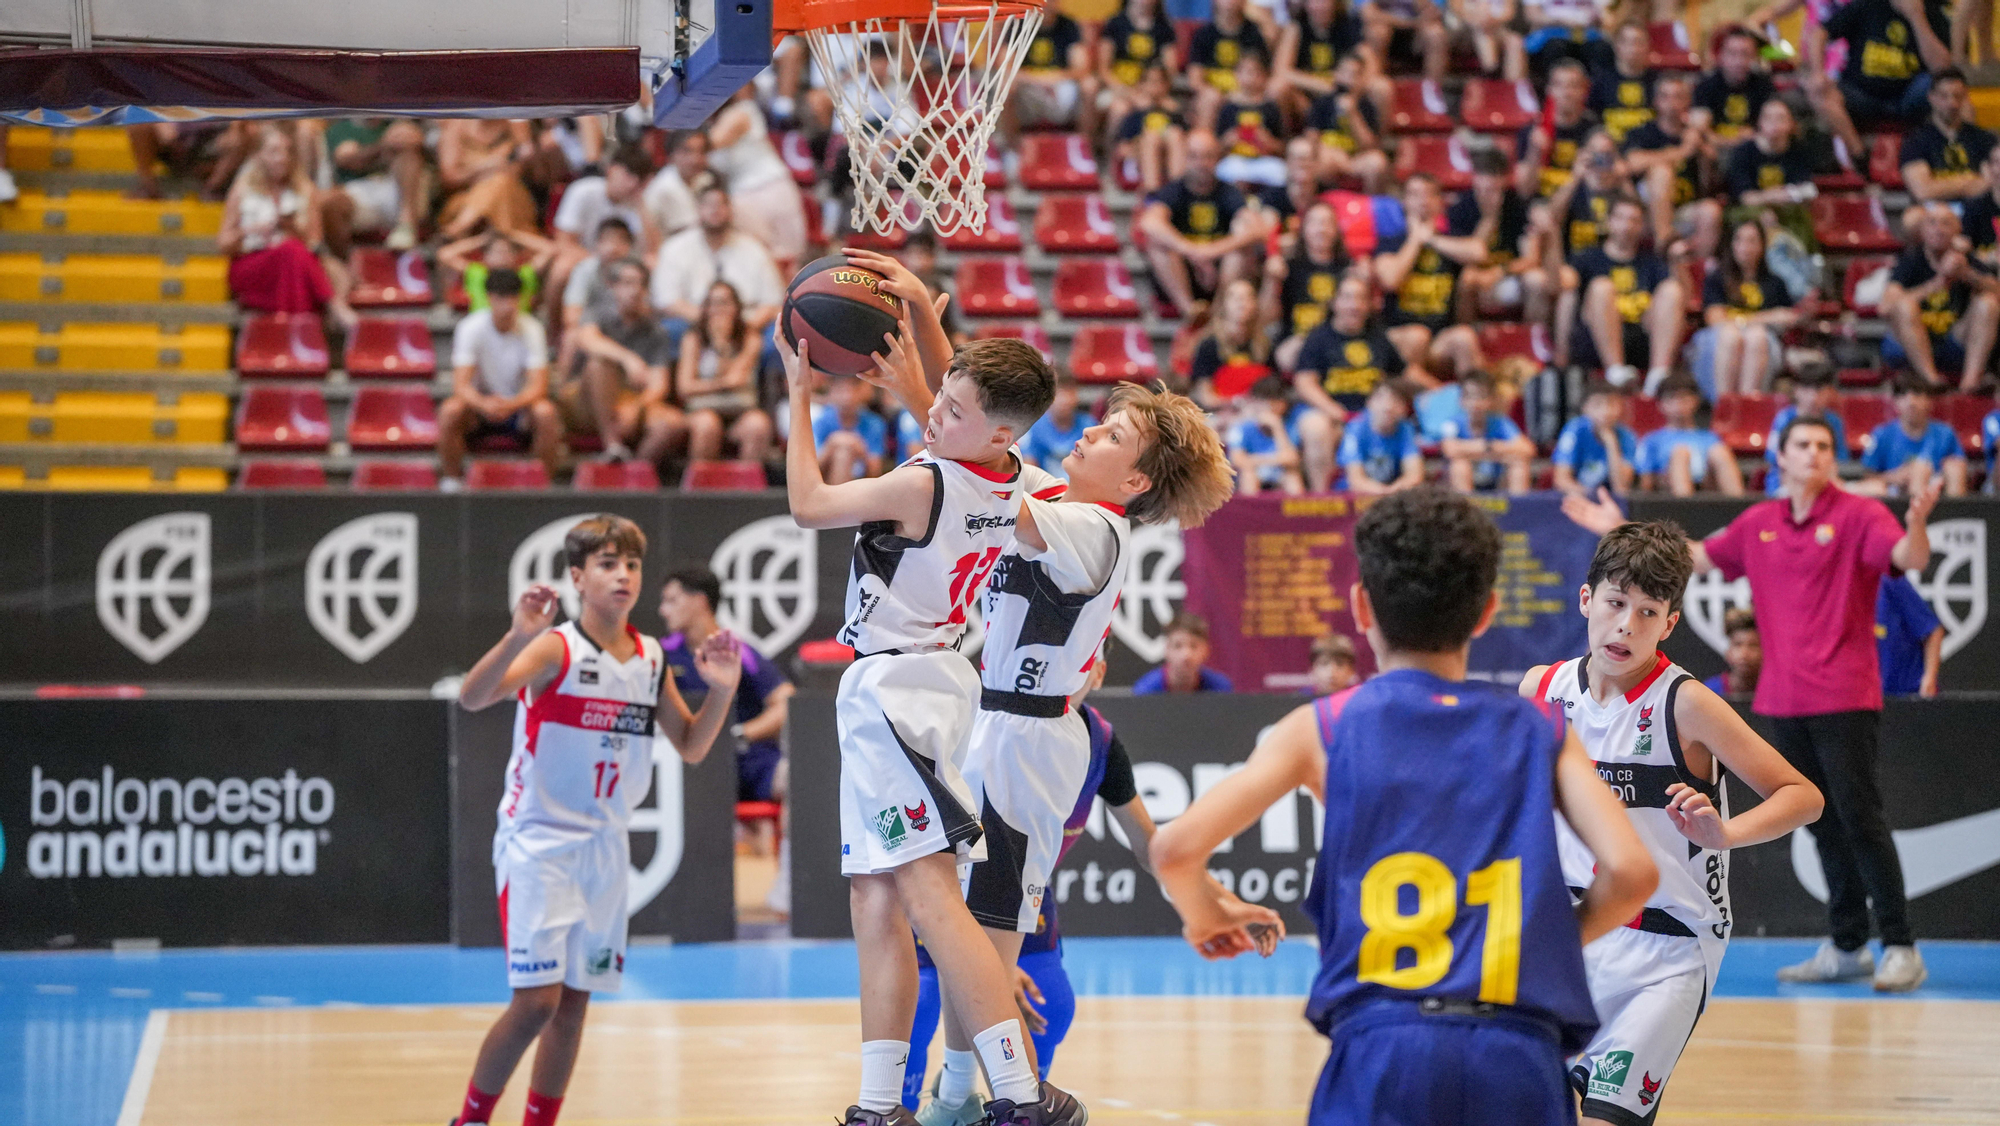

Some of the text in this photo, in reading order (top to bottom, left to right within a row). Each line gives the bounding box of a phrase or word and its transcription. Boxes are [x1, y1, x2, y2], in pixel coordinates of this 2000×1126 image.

[861, 596, 880, 623] limpieza
[594, 760, 620, 798] 17
[1617, 769, 1633, 782] CB
[30, 765, 334, 826] baloncesto
[1356, 851, 1522, 1005] 81
[511, 959, 558, 972] PULEVA
